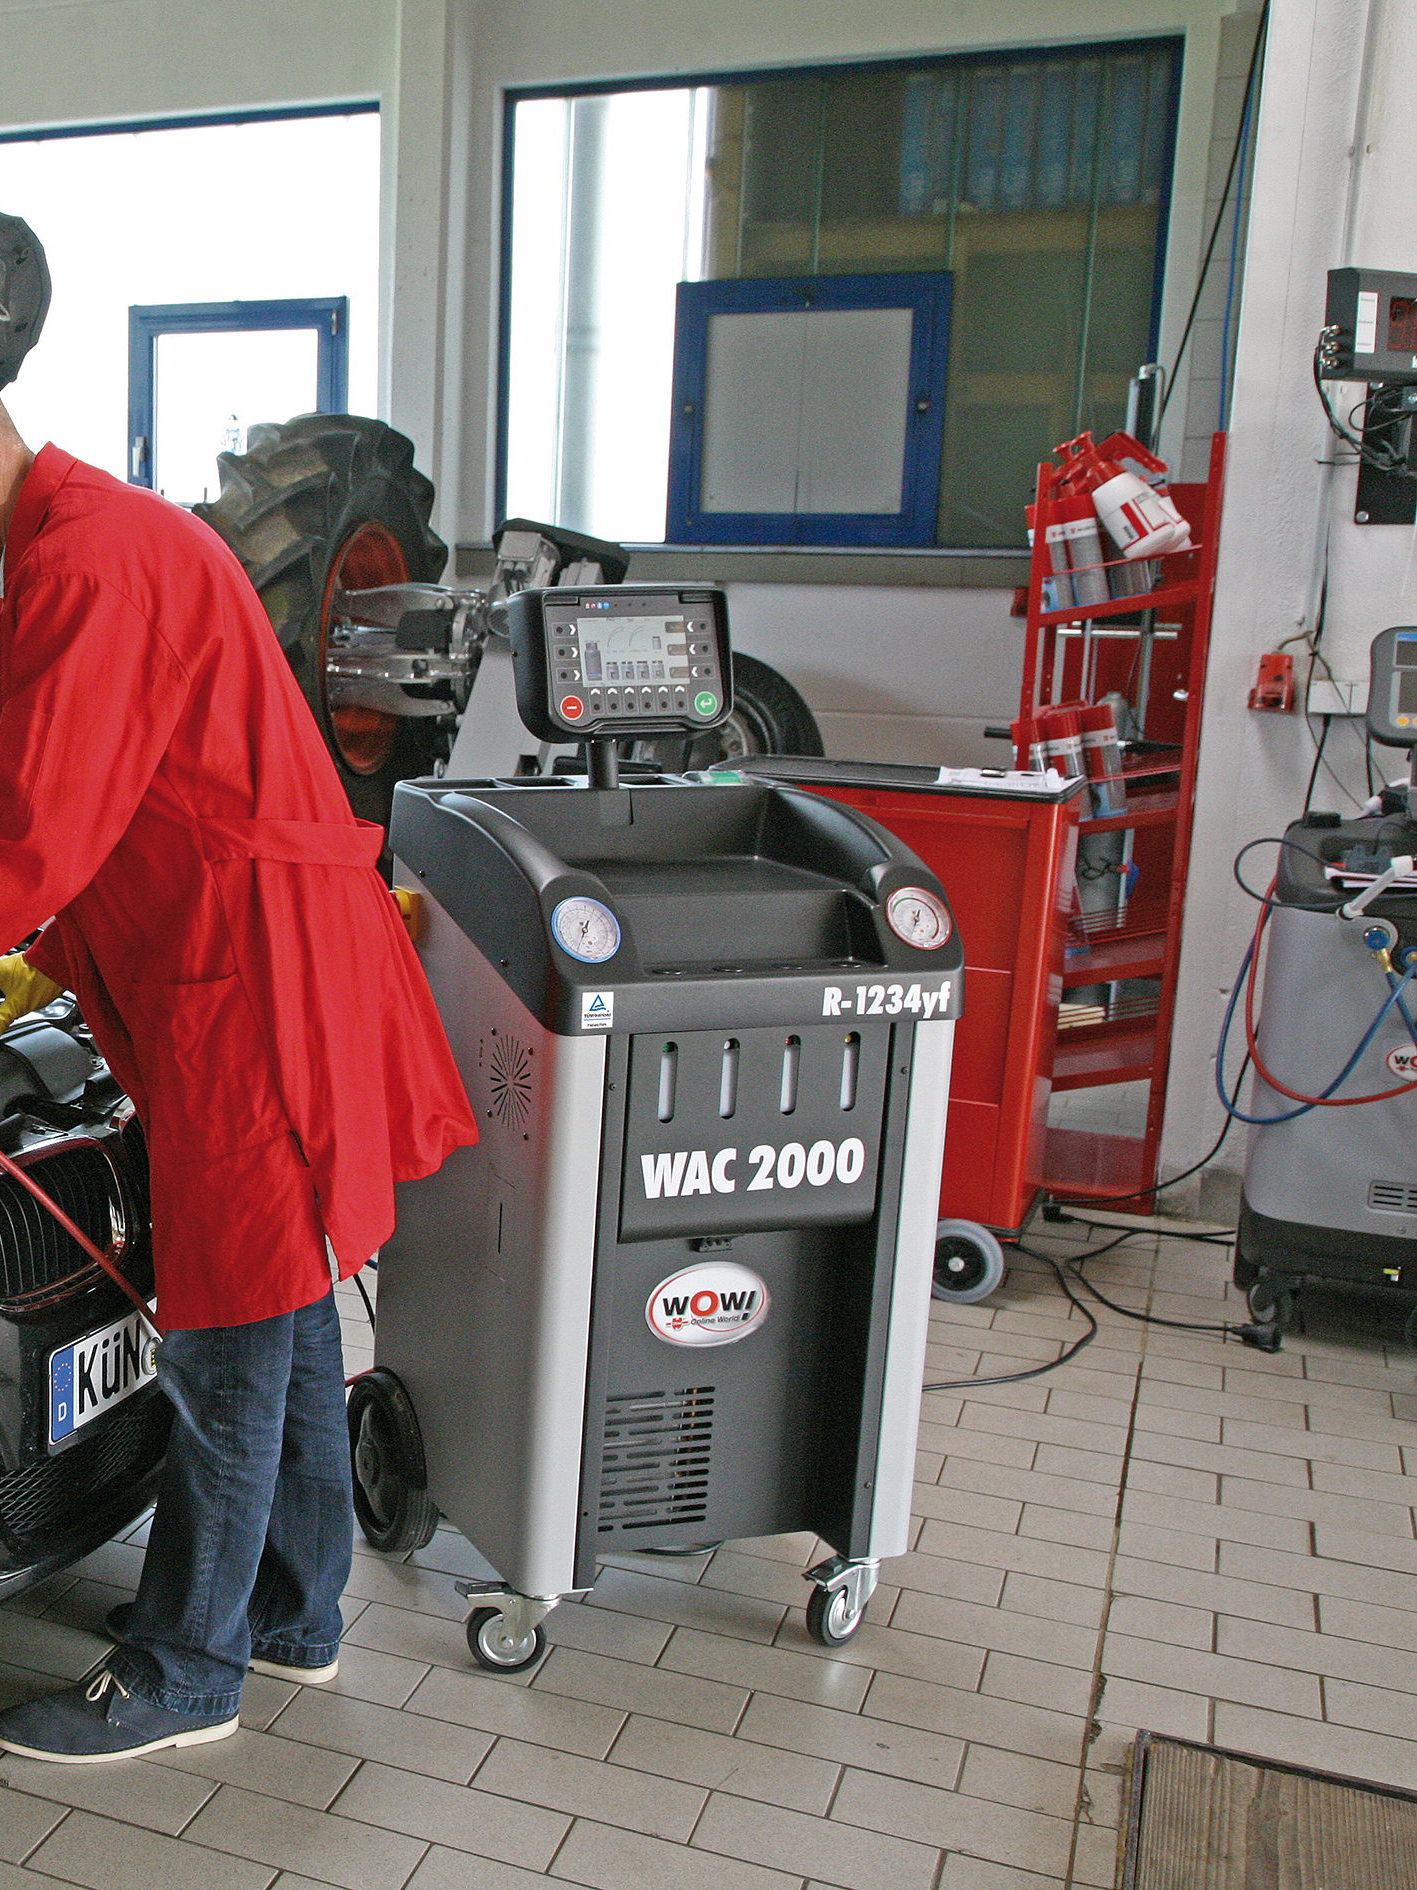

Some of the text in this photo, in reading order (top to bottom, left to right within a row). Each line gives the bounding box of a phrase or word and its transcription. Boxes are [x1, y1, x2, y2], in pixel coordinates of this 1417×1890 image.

[822, 981, 952, 1019] R-1234yf
[640, 1137, 865, 1199] WAC 2000
[662, 1290, 756, 1321] WOW!
[690, 1314, 740, 1326] Online World
[57, 1402, 68, 1423] D
